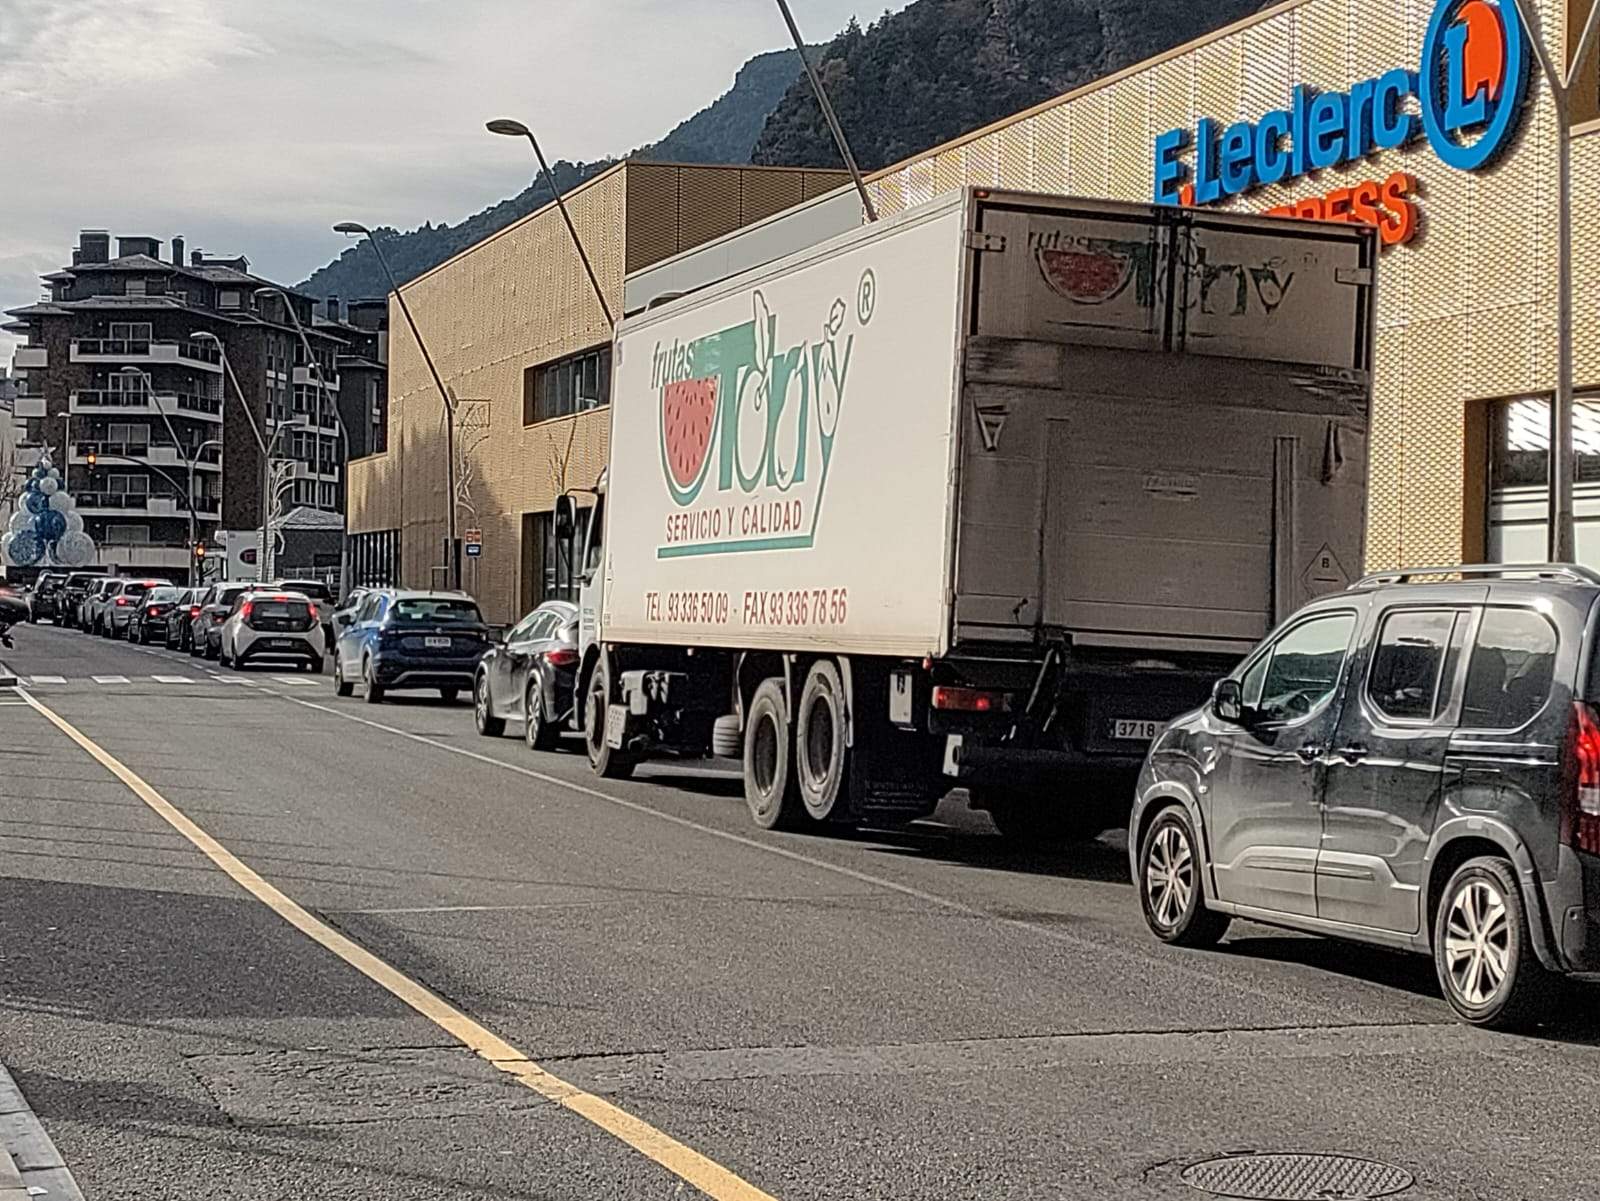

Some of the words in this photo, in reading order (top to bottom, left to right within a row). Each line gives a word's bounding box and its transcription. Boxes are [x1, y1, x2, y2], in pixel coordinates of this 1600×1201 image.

[651, 340, 694, 389] frutas
[666, 508, 721, 543] SERVICIO
[727, 506, 735, 535] Y
[742, 500, 802, 536] CALIDAD
[668, 592, 680, 622] 93
[680, 592, 698, 623] 336
[701, 592, 714, 623] 50
[715, 592, 729, 623] 09
[743, 591, 768, 625] FAX
[769, 591, 784, 625] 93
[786, 590, 809, 626] 336
[812, 589, 827, 625] 78
[830, 588, 847, 624] 56
[1119, 722, 1155, 737] 3718
